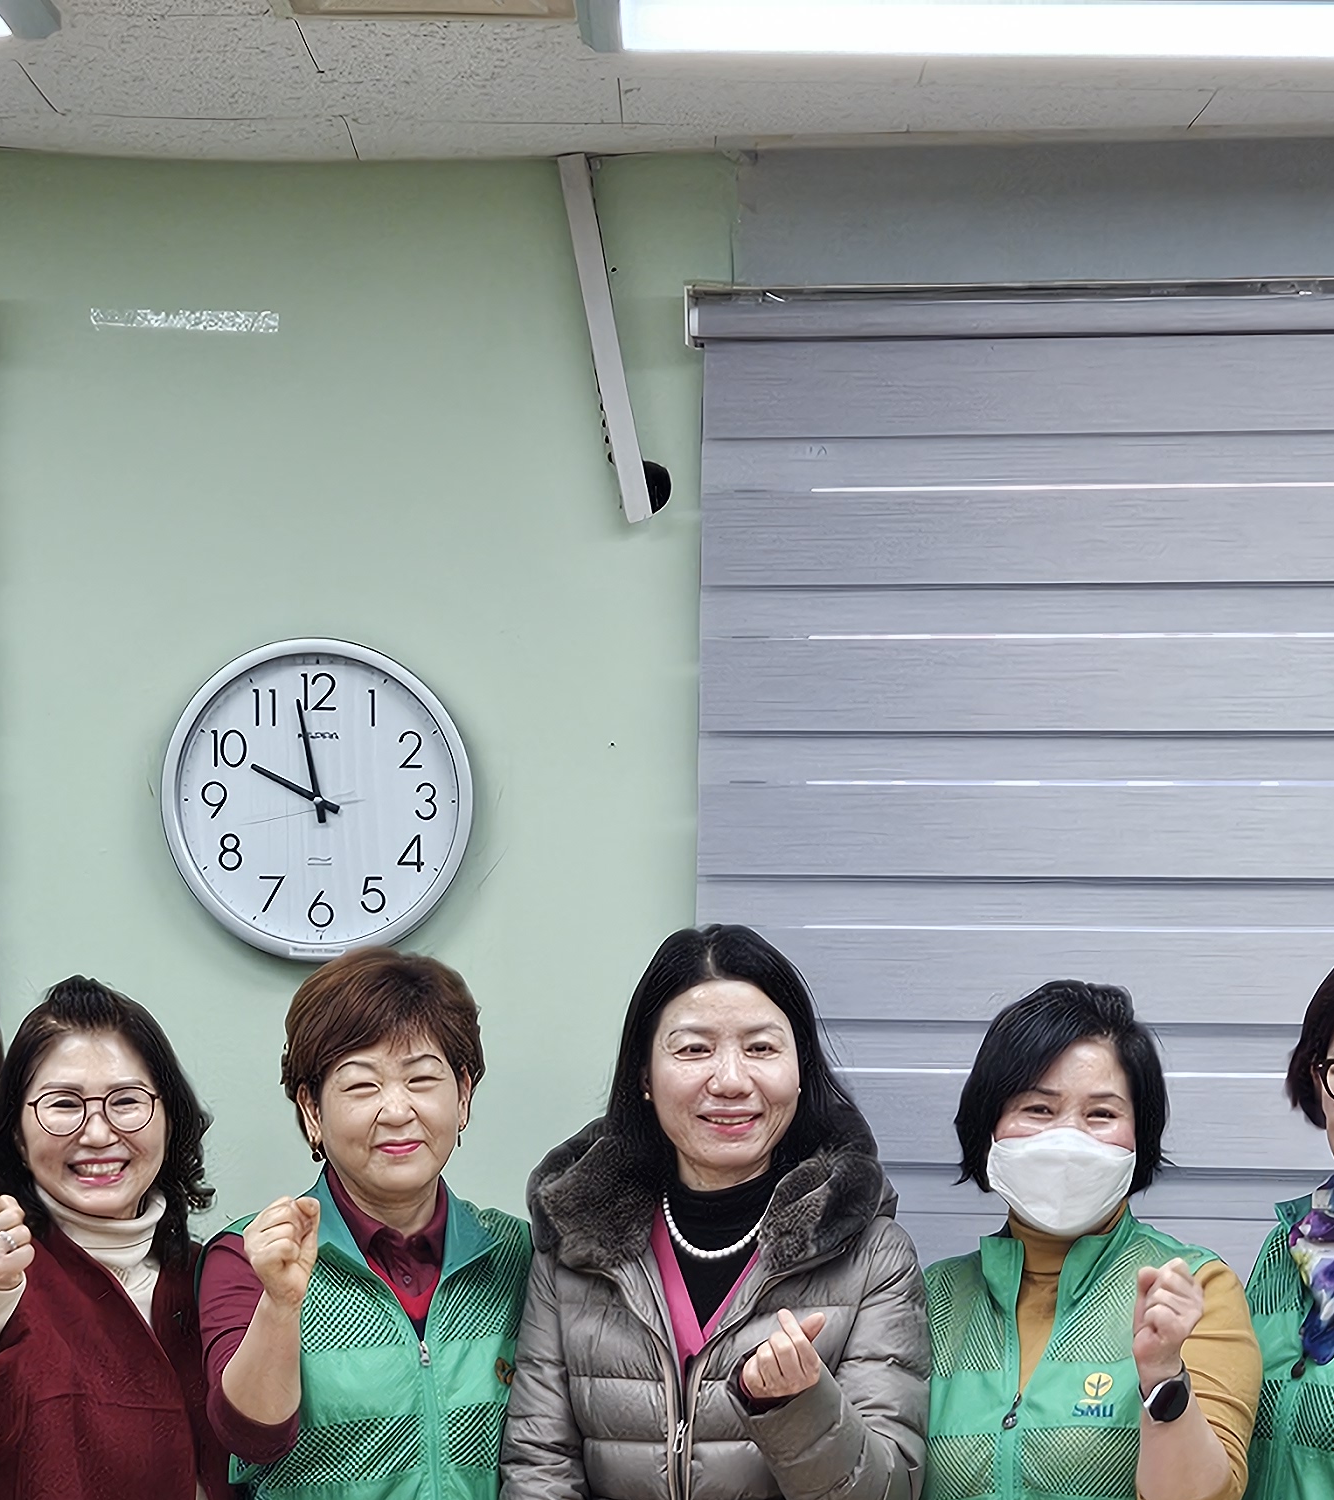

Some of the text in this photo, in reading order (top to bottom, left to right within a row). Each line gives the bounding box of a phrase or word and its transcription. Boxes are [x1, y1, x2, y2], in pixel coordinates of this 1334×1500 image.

[252, 688, 277, 727] 11
[300, 673, 336, 711] 12
[368, 688, 376, 727] 1
[211, 729, 247, 768] 10
[398, 730, 423, 769] 2
[201, 780, 228, 819] 9
[415, 782, 437, 821] 3
[218, 833, 243, 871] 8
[397, 834, 425, 873] 4
[259, 875, 286, 913] 7
[307, 890, 334, 928] 6
[360, 876, 386, 913] 5
[1072, 1403, 1114, 1418] SMU
